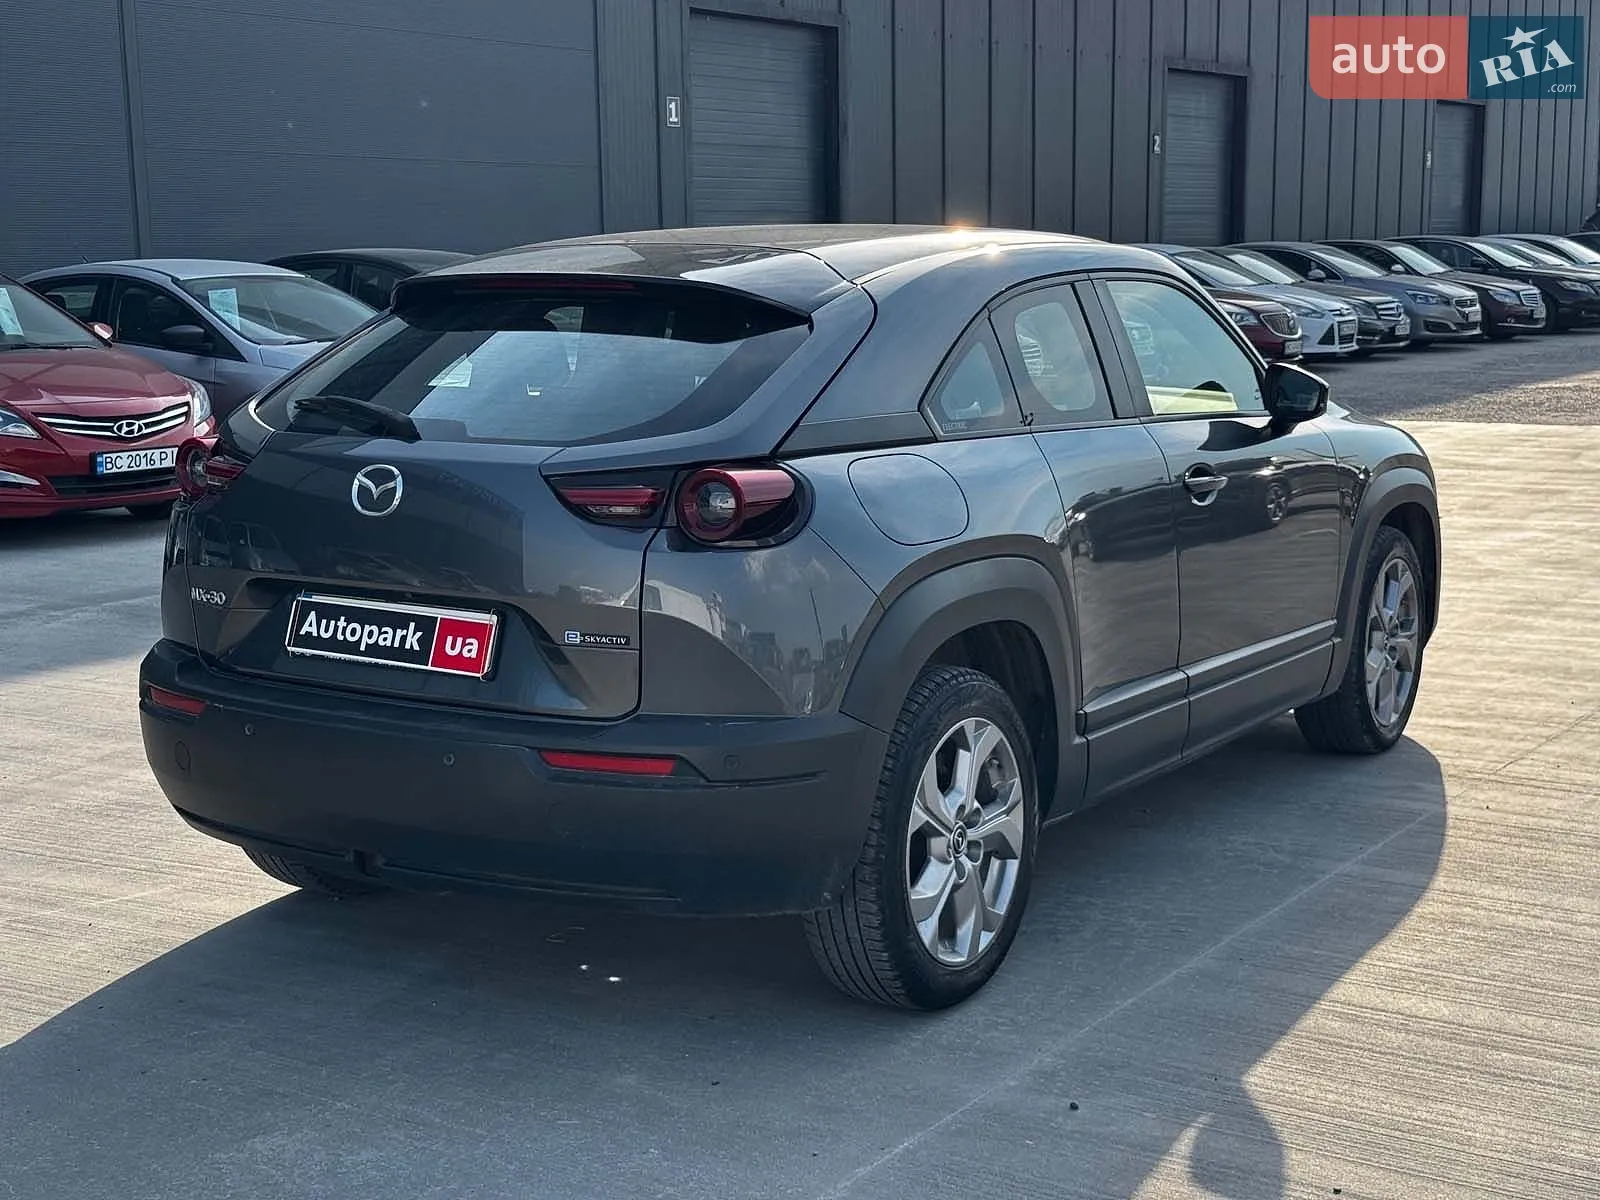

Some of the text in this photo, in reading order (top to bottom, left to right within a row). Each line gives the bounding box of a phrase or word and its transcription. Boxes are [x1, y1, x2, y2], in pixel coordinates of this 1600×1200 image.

[669, 101, 678, 122] 1
[1153, 135, 1161, 151] 2
[104, 456, 123, 471] BC
[126, 452, 156, 469] 2016
[190, 586, 226, 605] MX-30
[300, 610, 479, 659] Autopark ua
